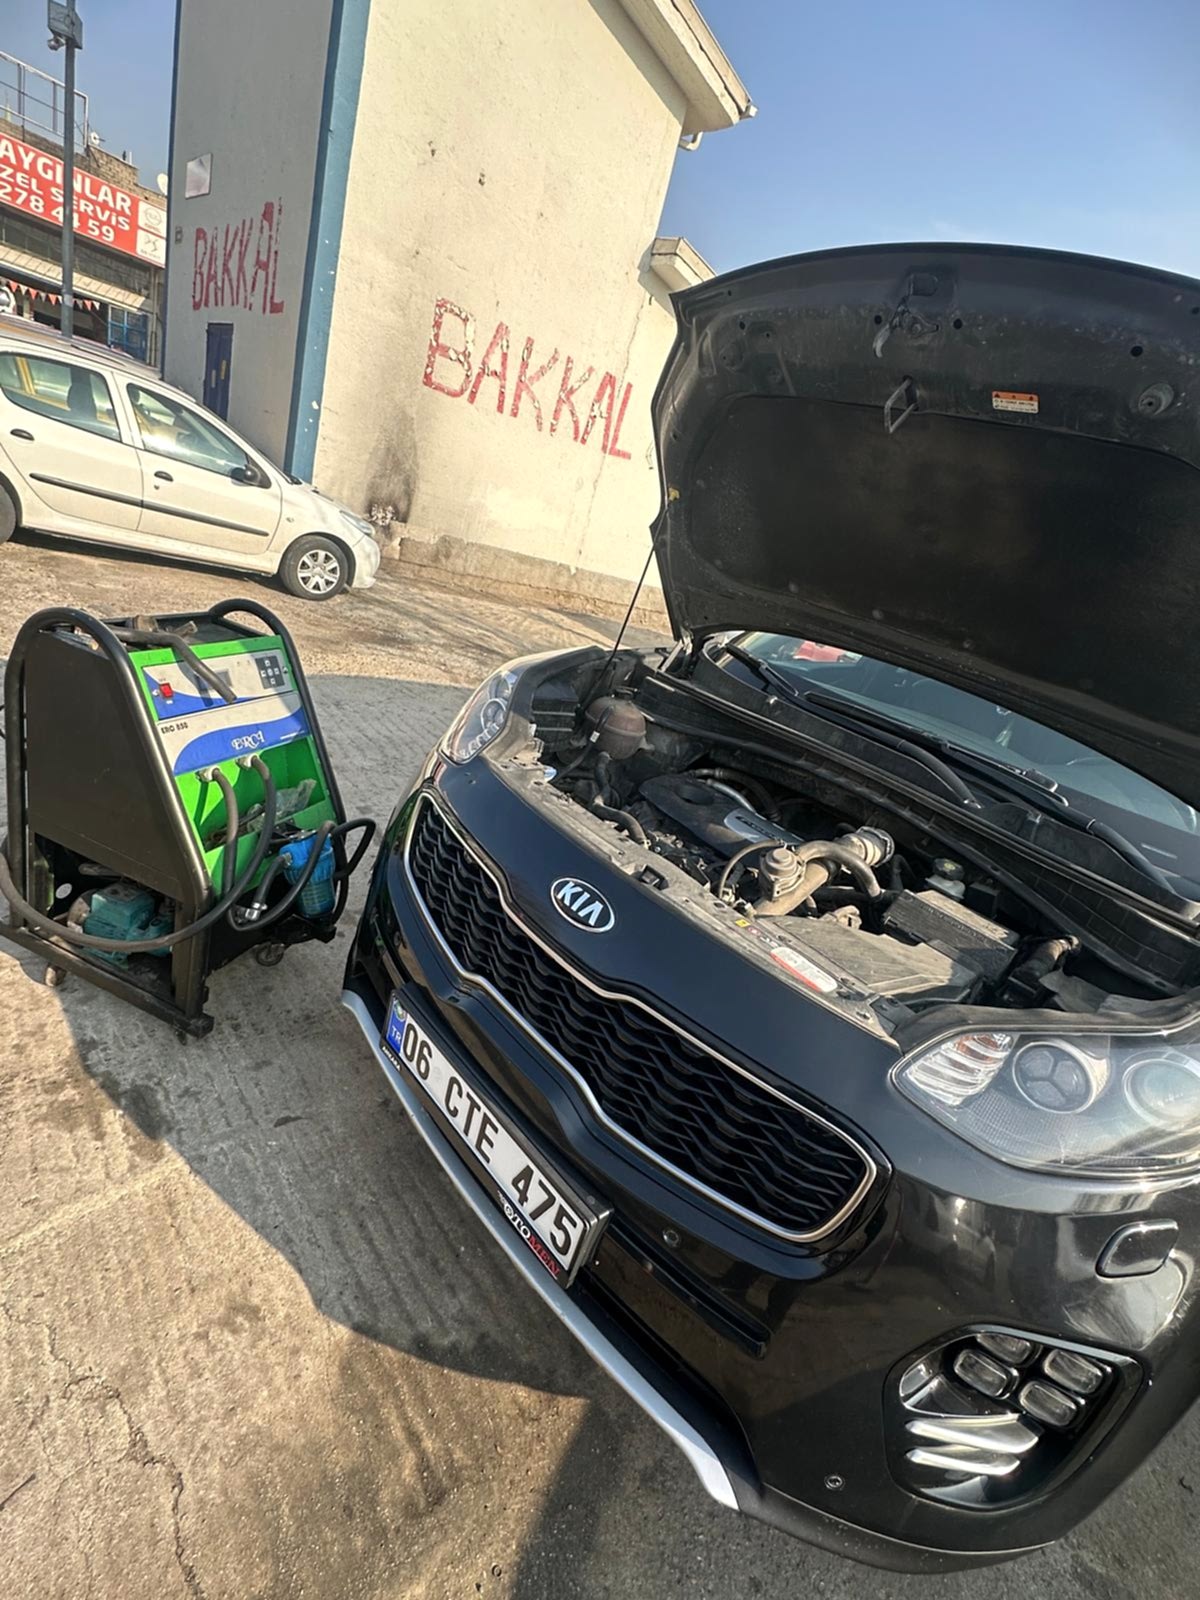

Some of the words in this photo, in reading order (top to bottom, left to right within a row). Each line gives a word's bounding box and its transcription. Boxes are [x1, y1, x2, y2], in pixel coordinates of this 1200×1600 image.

[0, 181, 45, 213] 278
[87, 218, 115, 241] 59
[192, 197, 285, 315] BAKKAL
[422, 297, 633, 460] BAKKAL
[556, 880, 604, 927] KIA
[391, 1025, 402, 1044] TR
[402, 1022, 433, 1080] 06
[444, 1076, 499, 1164] CTE
[511, 1165, 577, 1256] 475
